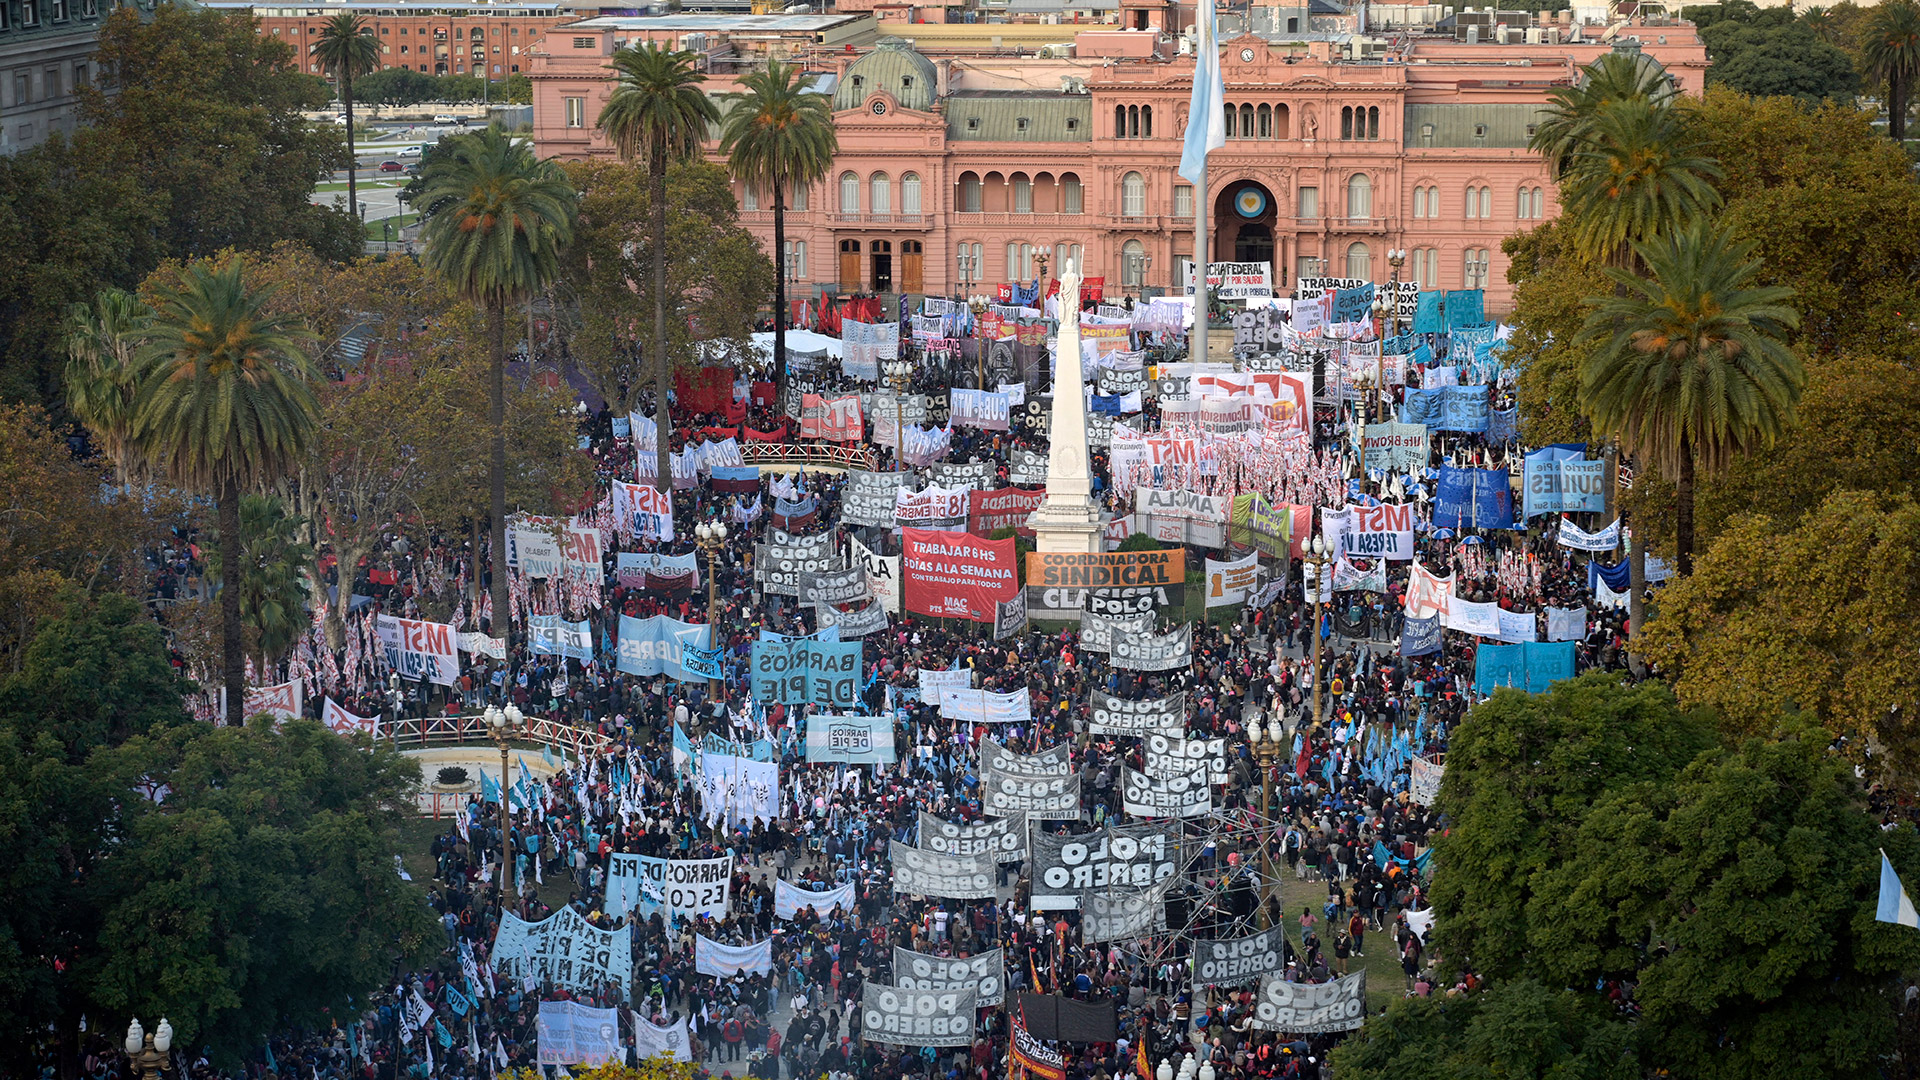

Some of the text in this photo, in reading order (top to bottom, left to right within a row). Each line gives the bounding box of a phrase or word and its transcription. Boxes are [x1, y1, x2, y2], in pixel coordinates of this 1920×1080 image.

[1190, 263, 1264, 275] MCHA FEDERAL
[1232, 276, 1241, 284] POR
[1243, 276, 1263, 284] SALARIO
[1000, 289, 1010, 297] 19
[1241, 288, 1248, 296] LA
[913, 542, 996, 561] TRABAJAR 6 HS
[1043, 553, 1168, 565] COORDINADORA
[905, 557, 1013, 579] 5 DÍAS A LA SEMANA
[912, 573, 924, 581] CON
[926, 575, 955, 584] TRABAJO
[978, 580, 1002, 588] TODOS
[1044, 565, 1169, 585] SINDICAL
[944, 596, 967, 607] MAC
[1043, 586, 1169, 608] CLAA
[929, 605, 942, 613] PTS
[1092, 596, 1152, 614] POLO
[1016, 1038, 1063, 1066] QUIERDA
